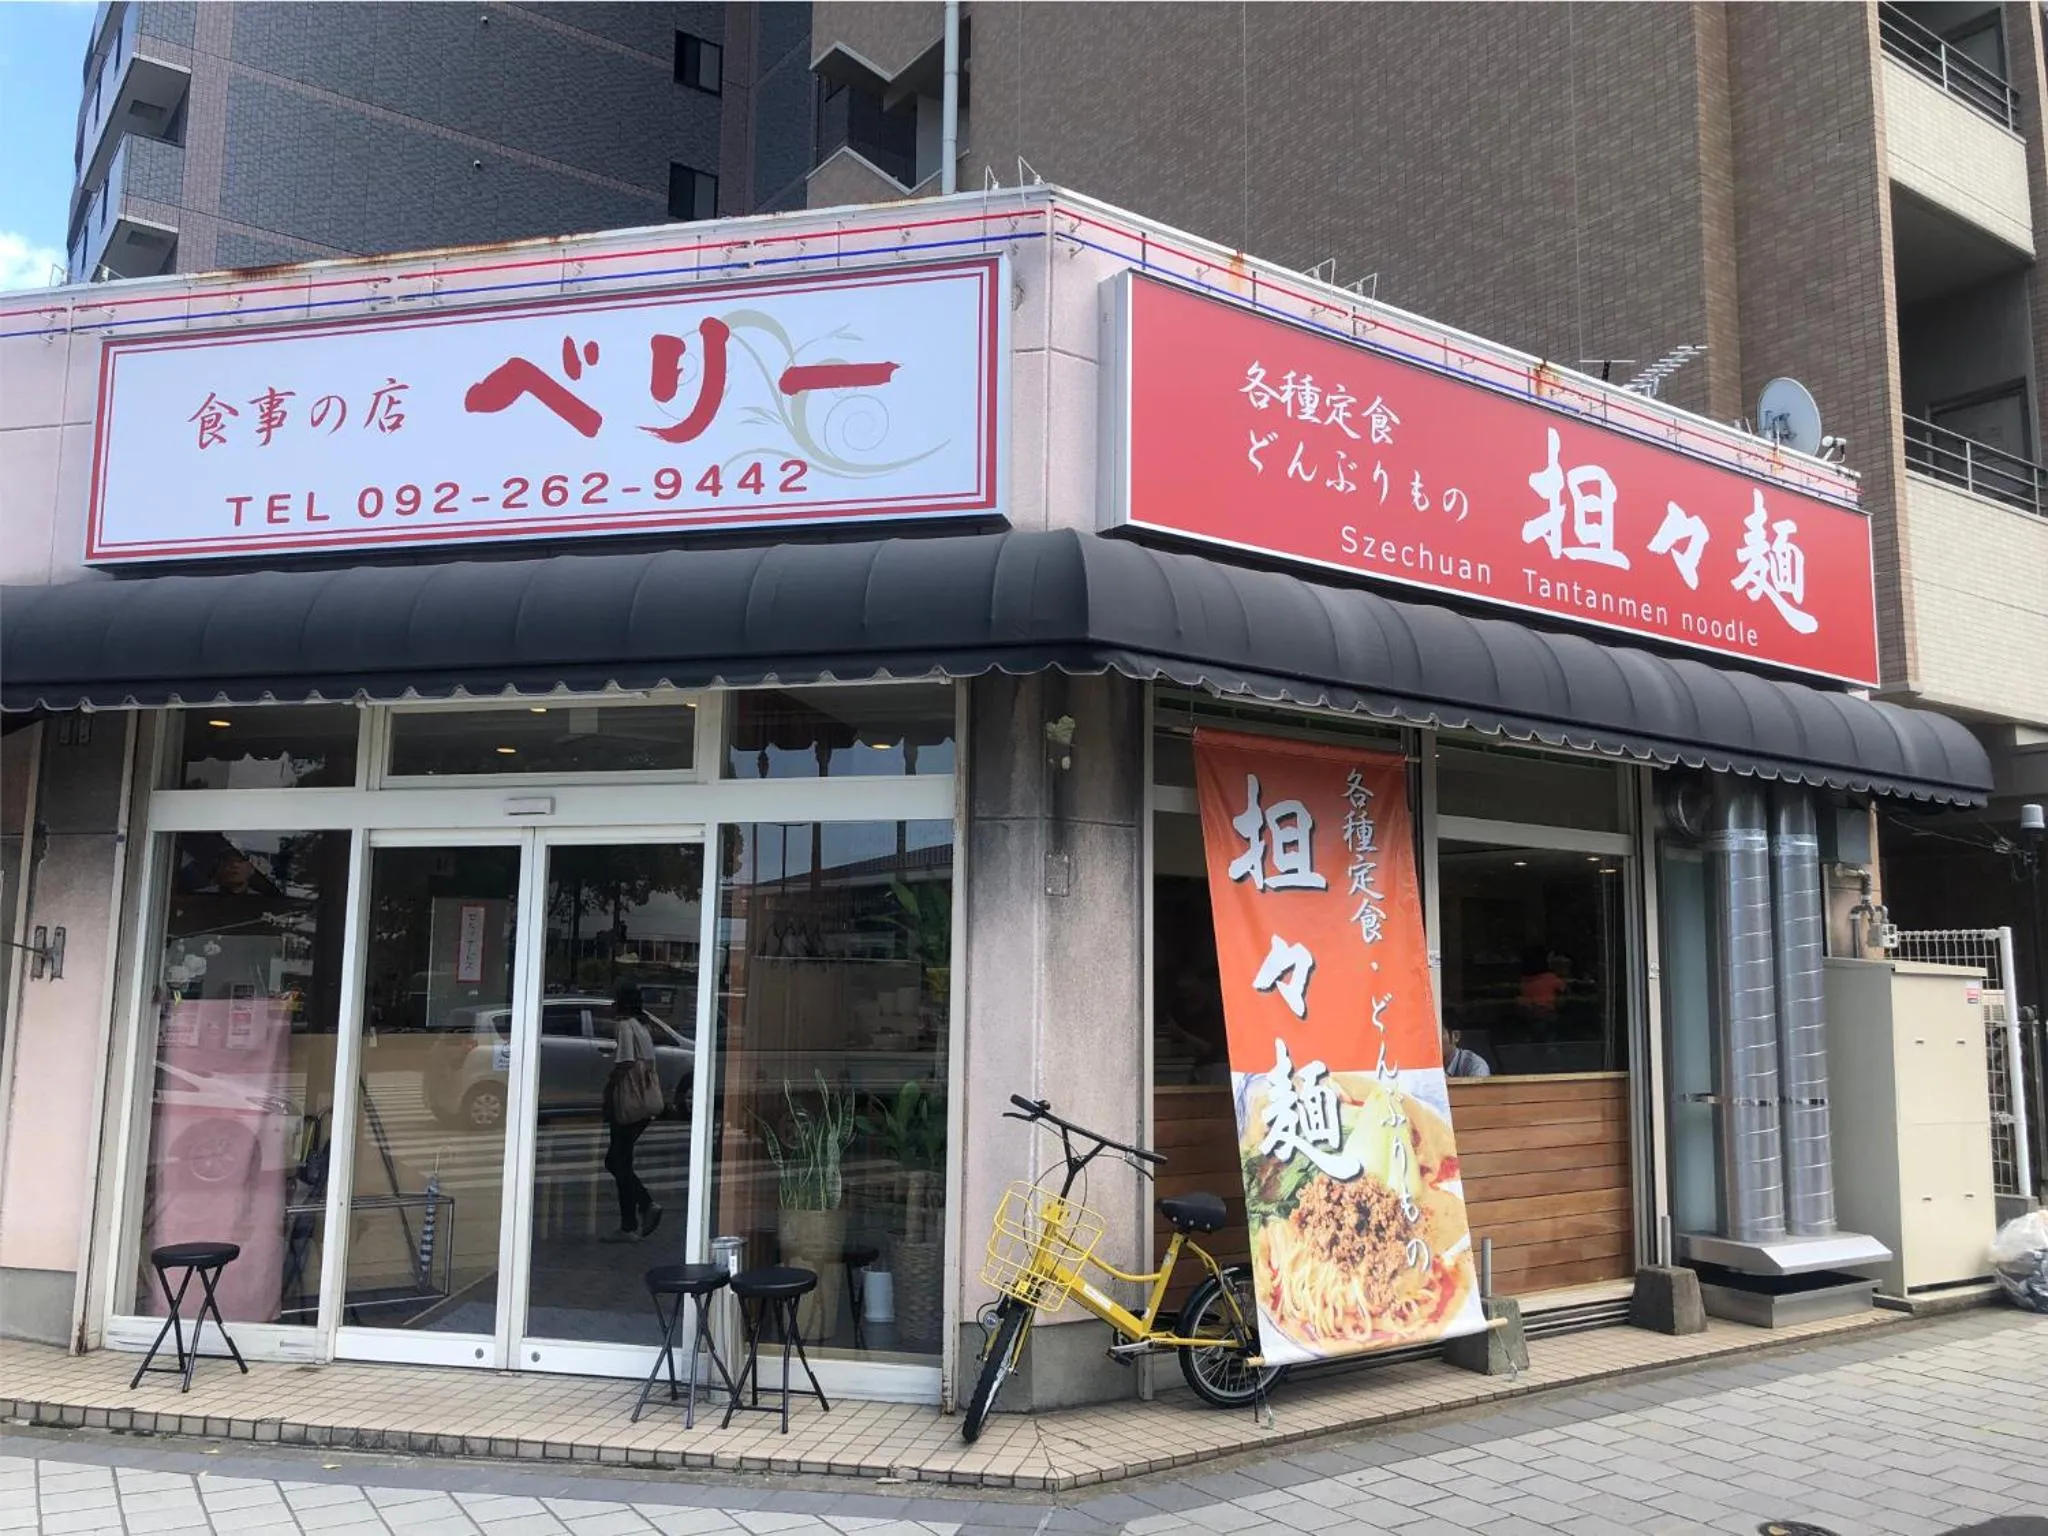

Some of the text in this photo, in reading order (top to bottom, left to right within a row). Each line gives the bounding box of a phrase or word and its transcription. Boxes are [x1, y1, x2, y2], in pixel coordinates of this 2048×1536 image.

[187, 316, 901, 450] 食事の店 ベリー
[1239, 361, 1400, 445] 各種定食
[226, 459, 809, 526] TEL 092-262-9442
[1246, 430, 1469, 521] どんぶりもの
[1521, 427, 1818, 633] 担々麺
[1341, 526, 1759, 648] Szechuan Tantanmen noodle
[1228, 773, 1364, 1181] 担々麺
